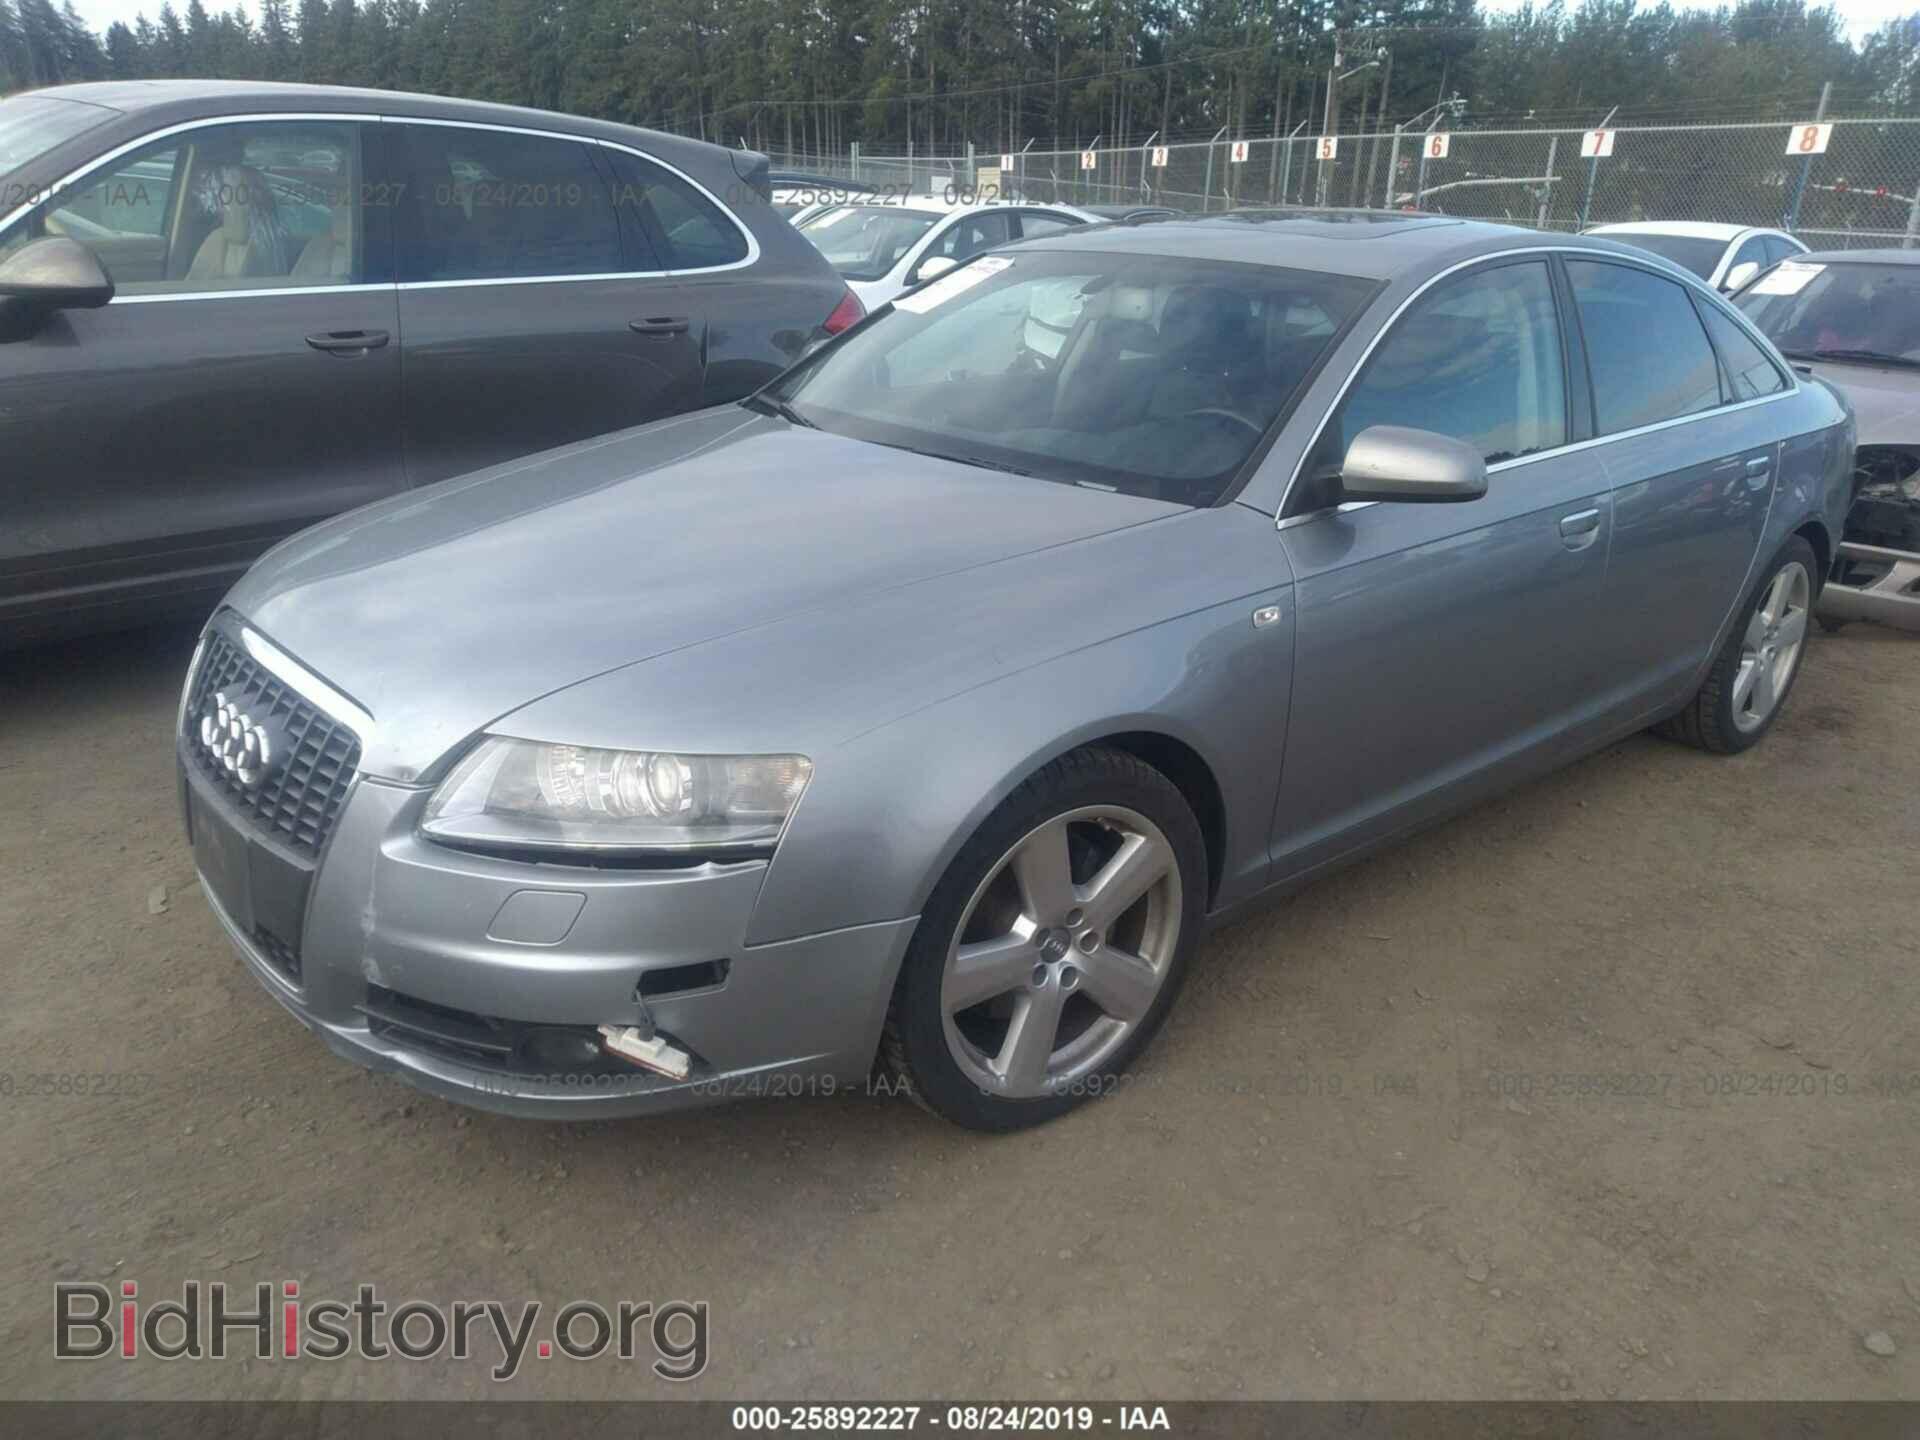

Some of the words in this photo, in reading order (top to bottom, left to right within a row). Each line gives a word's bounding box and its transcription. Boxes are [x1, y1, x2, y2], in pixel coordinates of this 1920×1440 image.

[1322, 138, 1331, 157] 5
[1431, 136, 1441, 156] 6
[1594, 132, 1605, 155] 7
[1800, 127, 1818, 152] 8
[1085, 152, 1092, 167] 2
[1156, 149, 1164, 164] 3
[1236, 143, 1244, 160] 4
